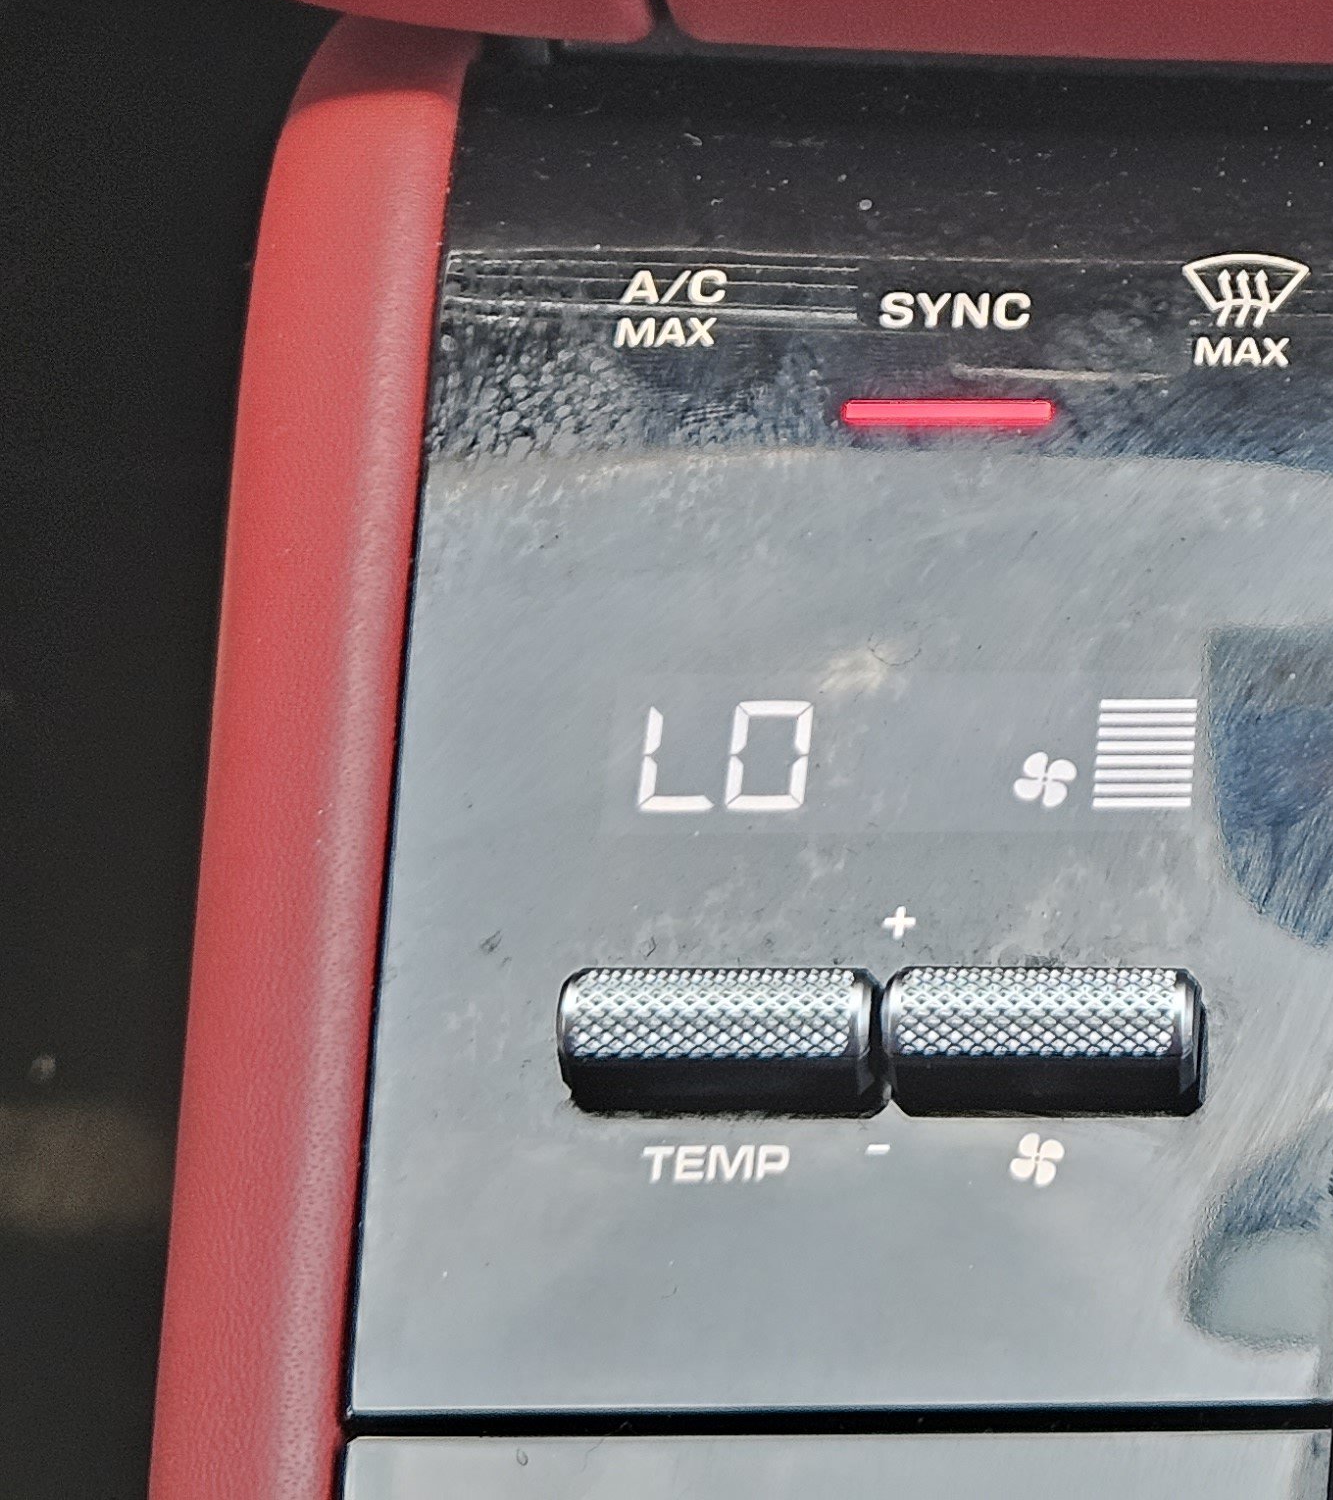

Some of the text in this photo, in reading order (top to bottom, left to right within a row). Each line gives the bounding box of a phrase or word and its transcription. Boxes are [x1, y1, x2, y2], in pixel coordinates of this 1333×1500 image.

[621, 268, 728, 307] A/C
[879, 292, 1031, 330] SYNC
[613, 317, 718, 348] MAX
[1194, 337, 1290, 368] MAX
[637, 700, 814, 813] LO
[643, 1144, 791, 1184] TEMP
